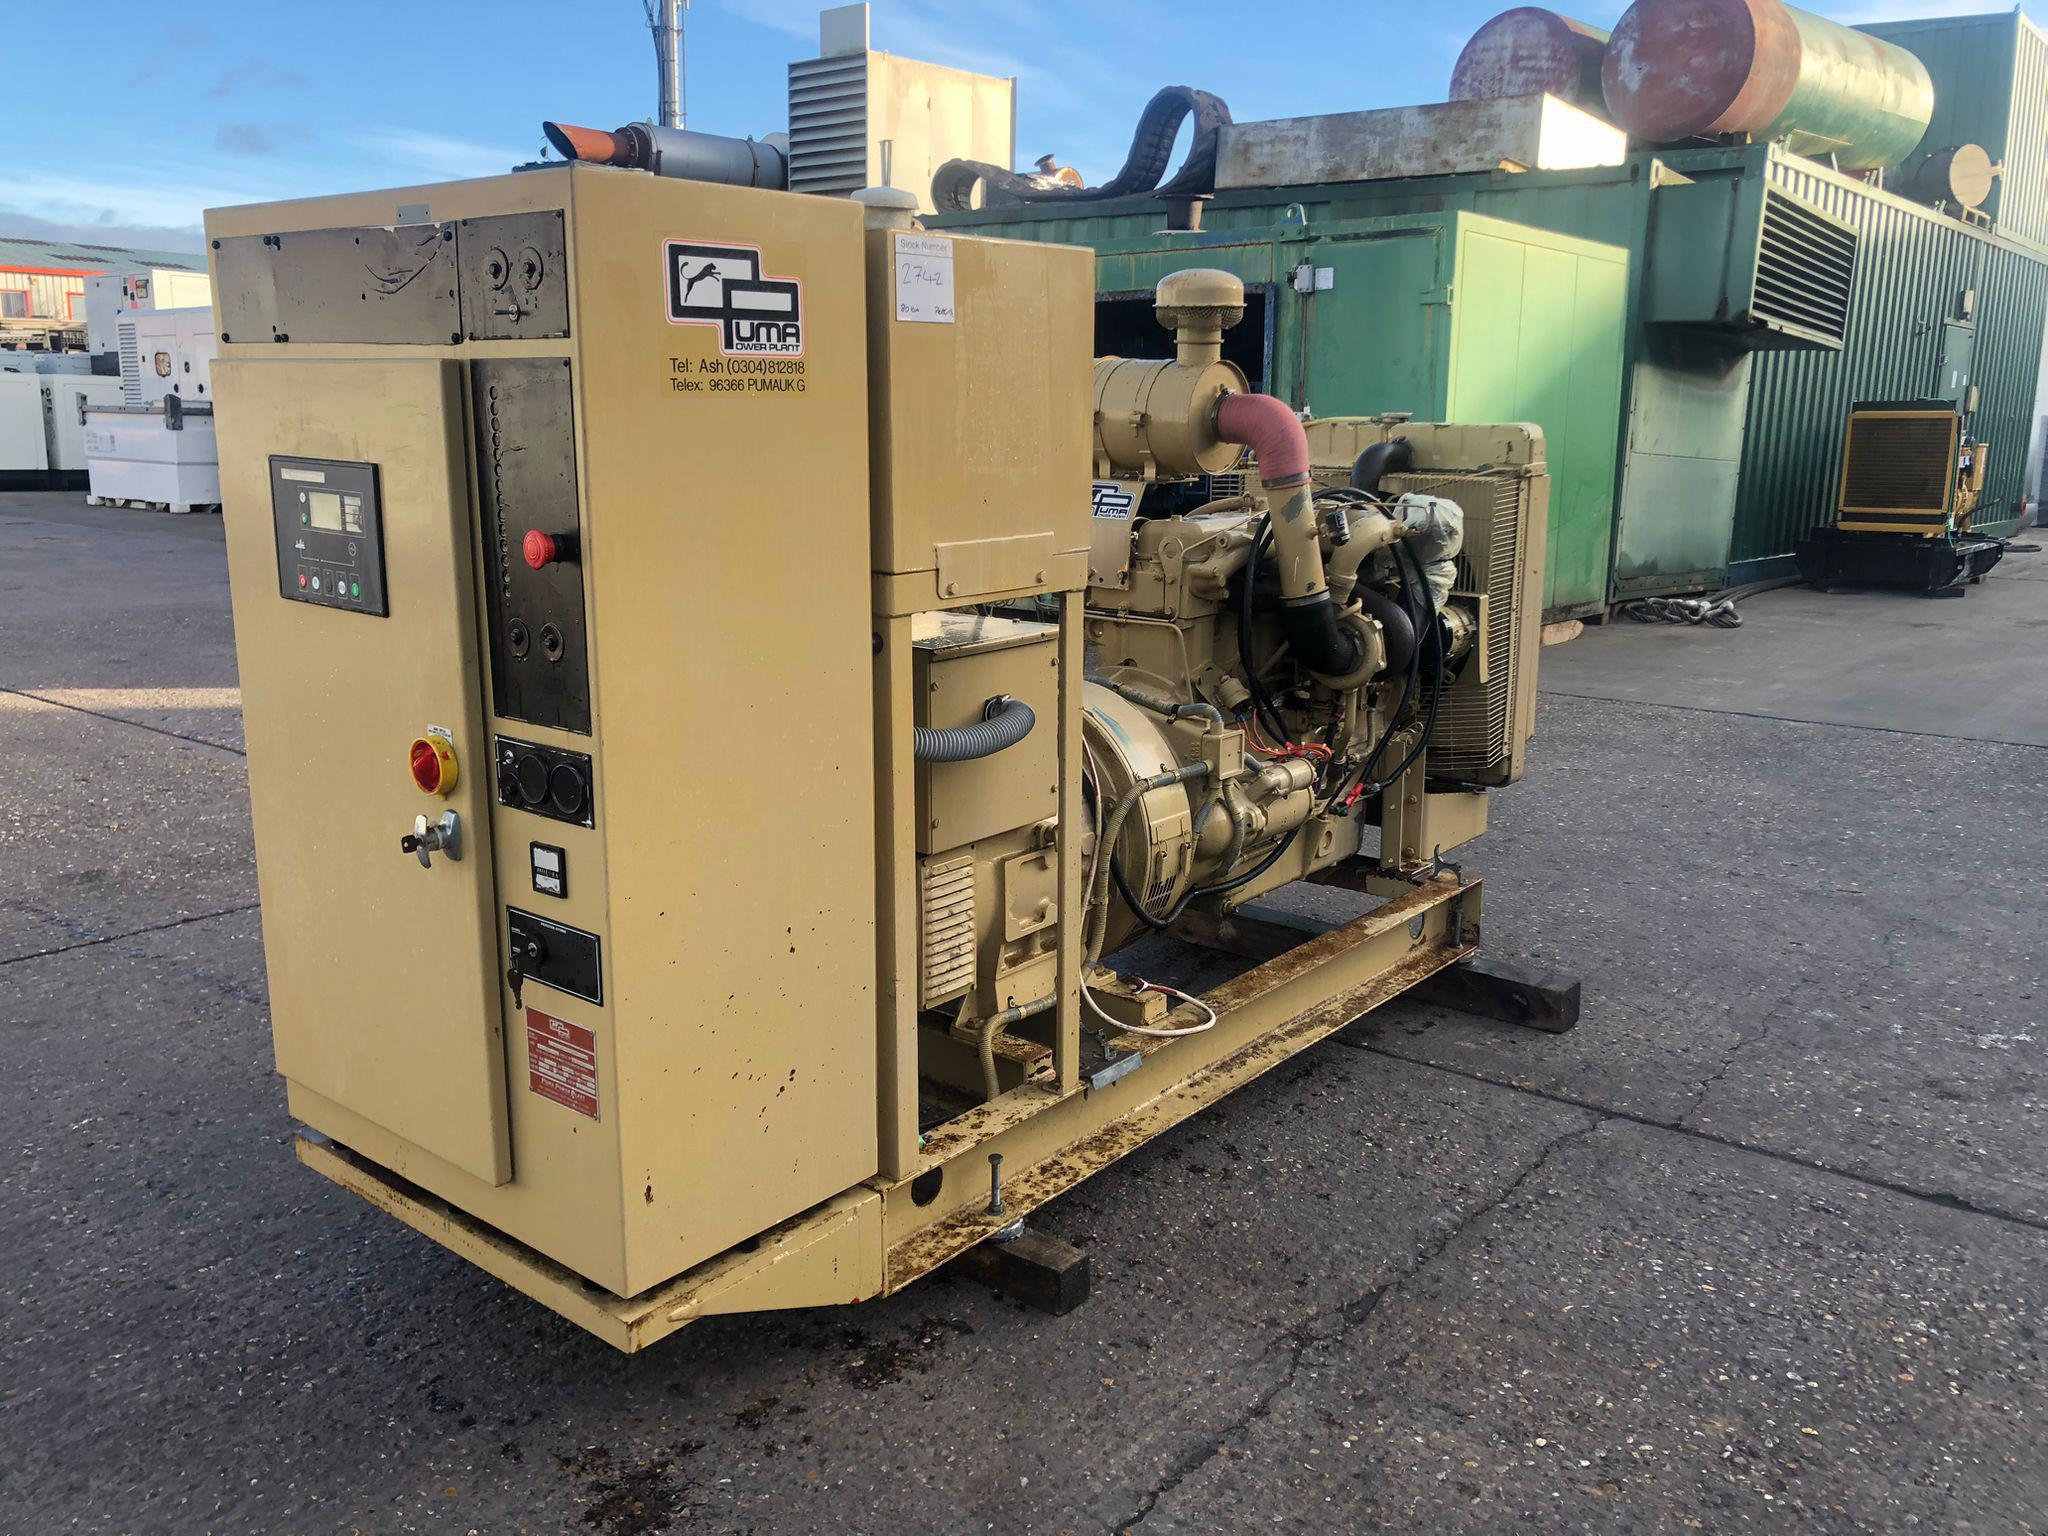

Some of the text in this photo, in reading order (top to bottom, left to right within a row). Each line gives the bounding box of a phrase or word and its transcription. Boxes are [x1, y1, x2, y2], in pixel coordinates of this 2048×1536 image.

[901, 262, 943, 286] 2742
[669, 358, 693, 374] Tel:
[699, 359, 724, 374] Ash
[669, 378, 806, 392] Telex: 96366 PUMAUK G
